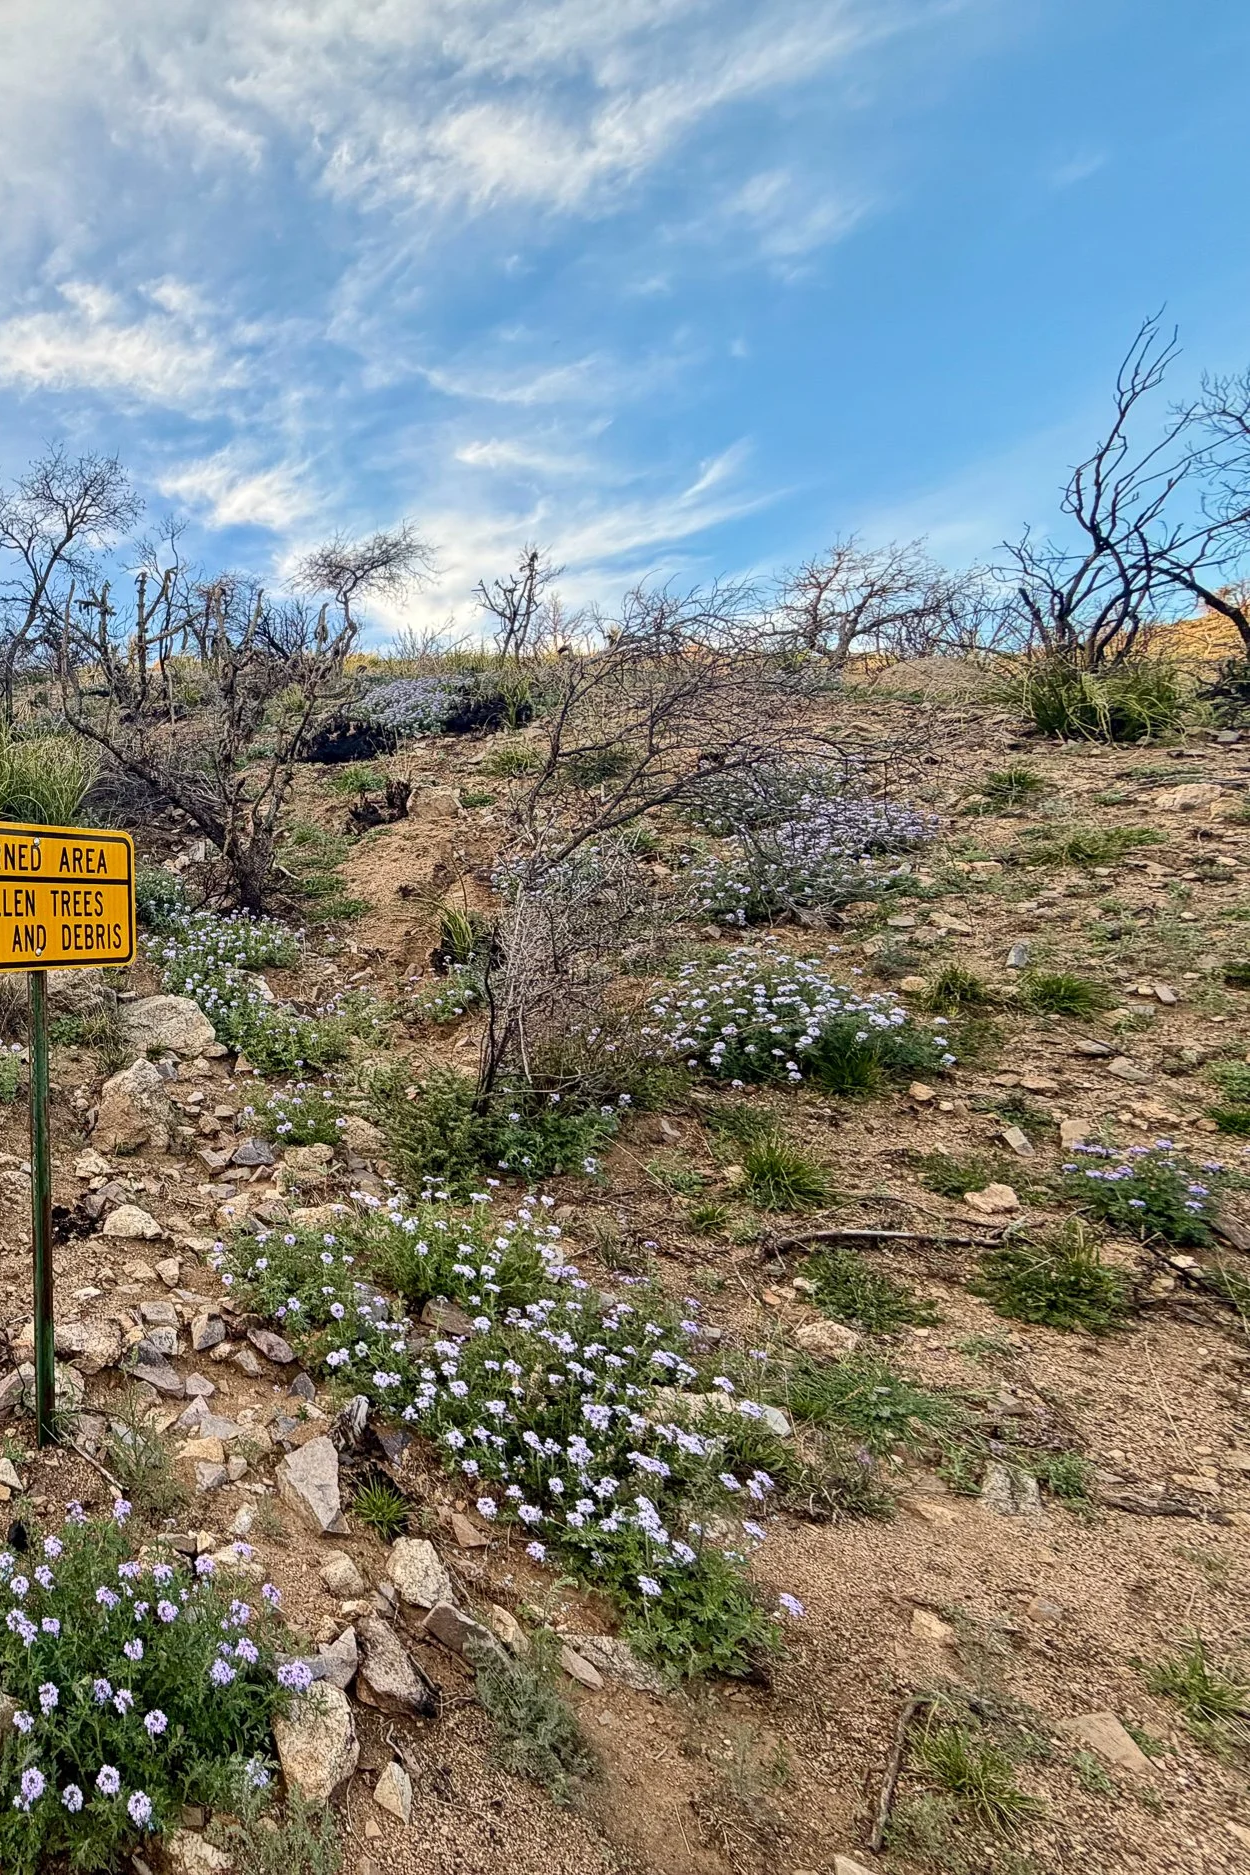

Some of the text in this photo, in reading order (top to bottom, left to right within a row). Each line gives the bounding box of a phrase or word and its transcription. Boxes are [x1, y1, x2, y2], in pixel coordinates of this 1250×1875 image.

[59, 847, 108, 874] AREA
[50, 890, 104, 917] TREES
[12, 924, 47, 953] AND
[61, 923, 122, 951] DEBRIS
